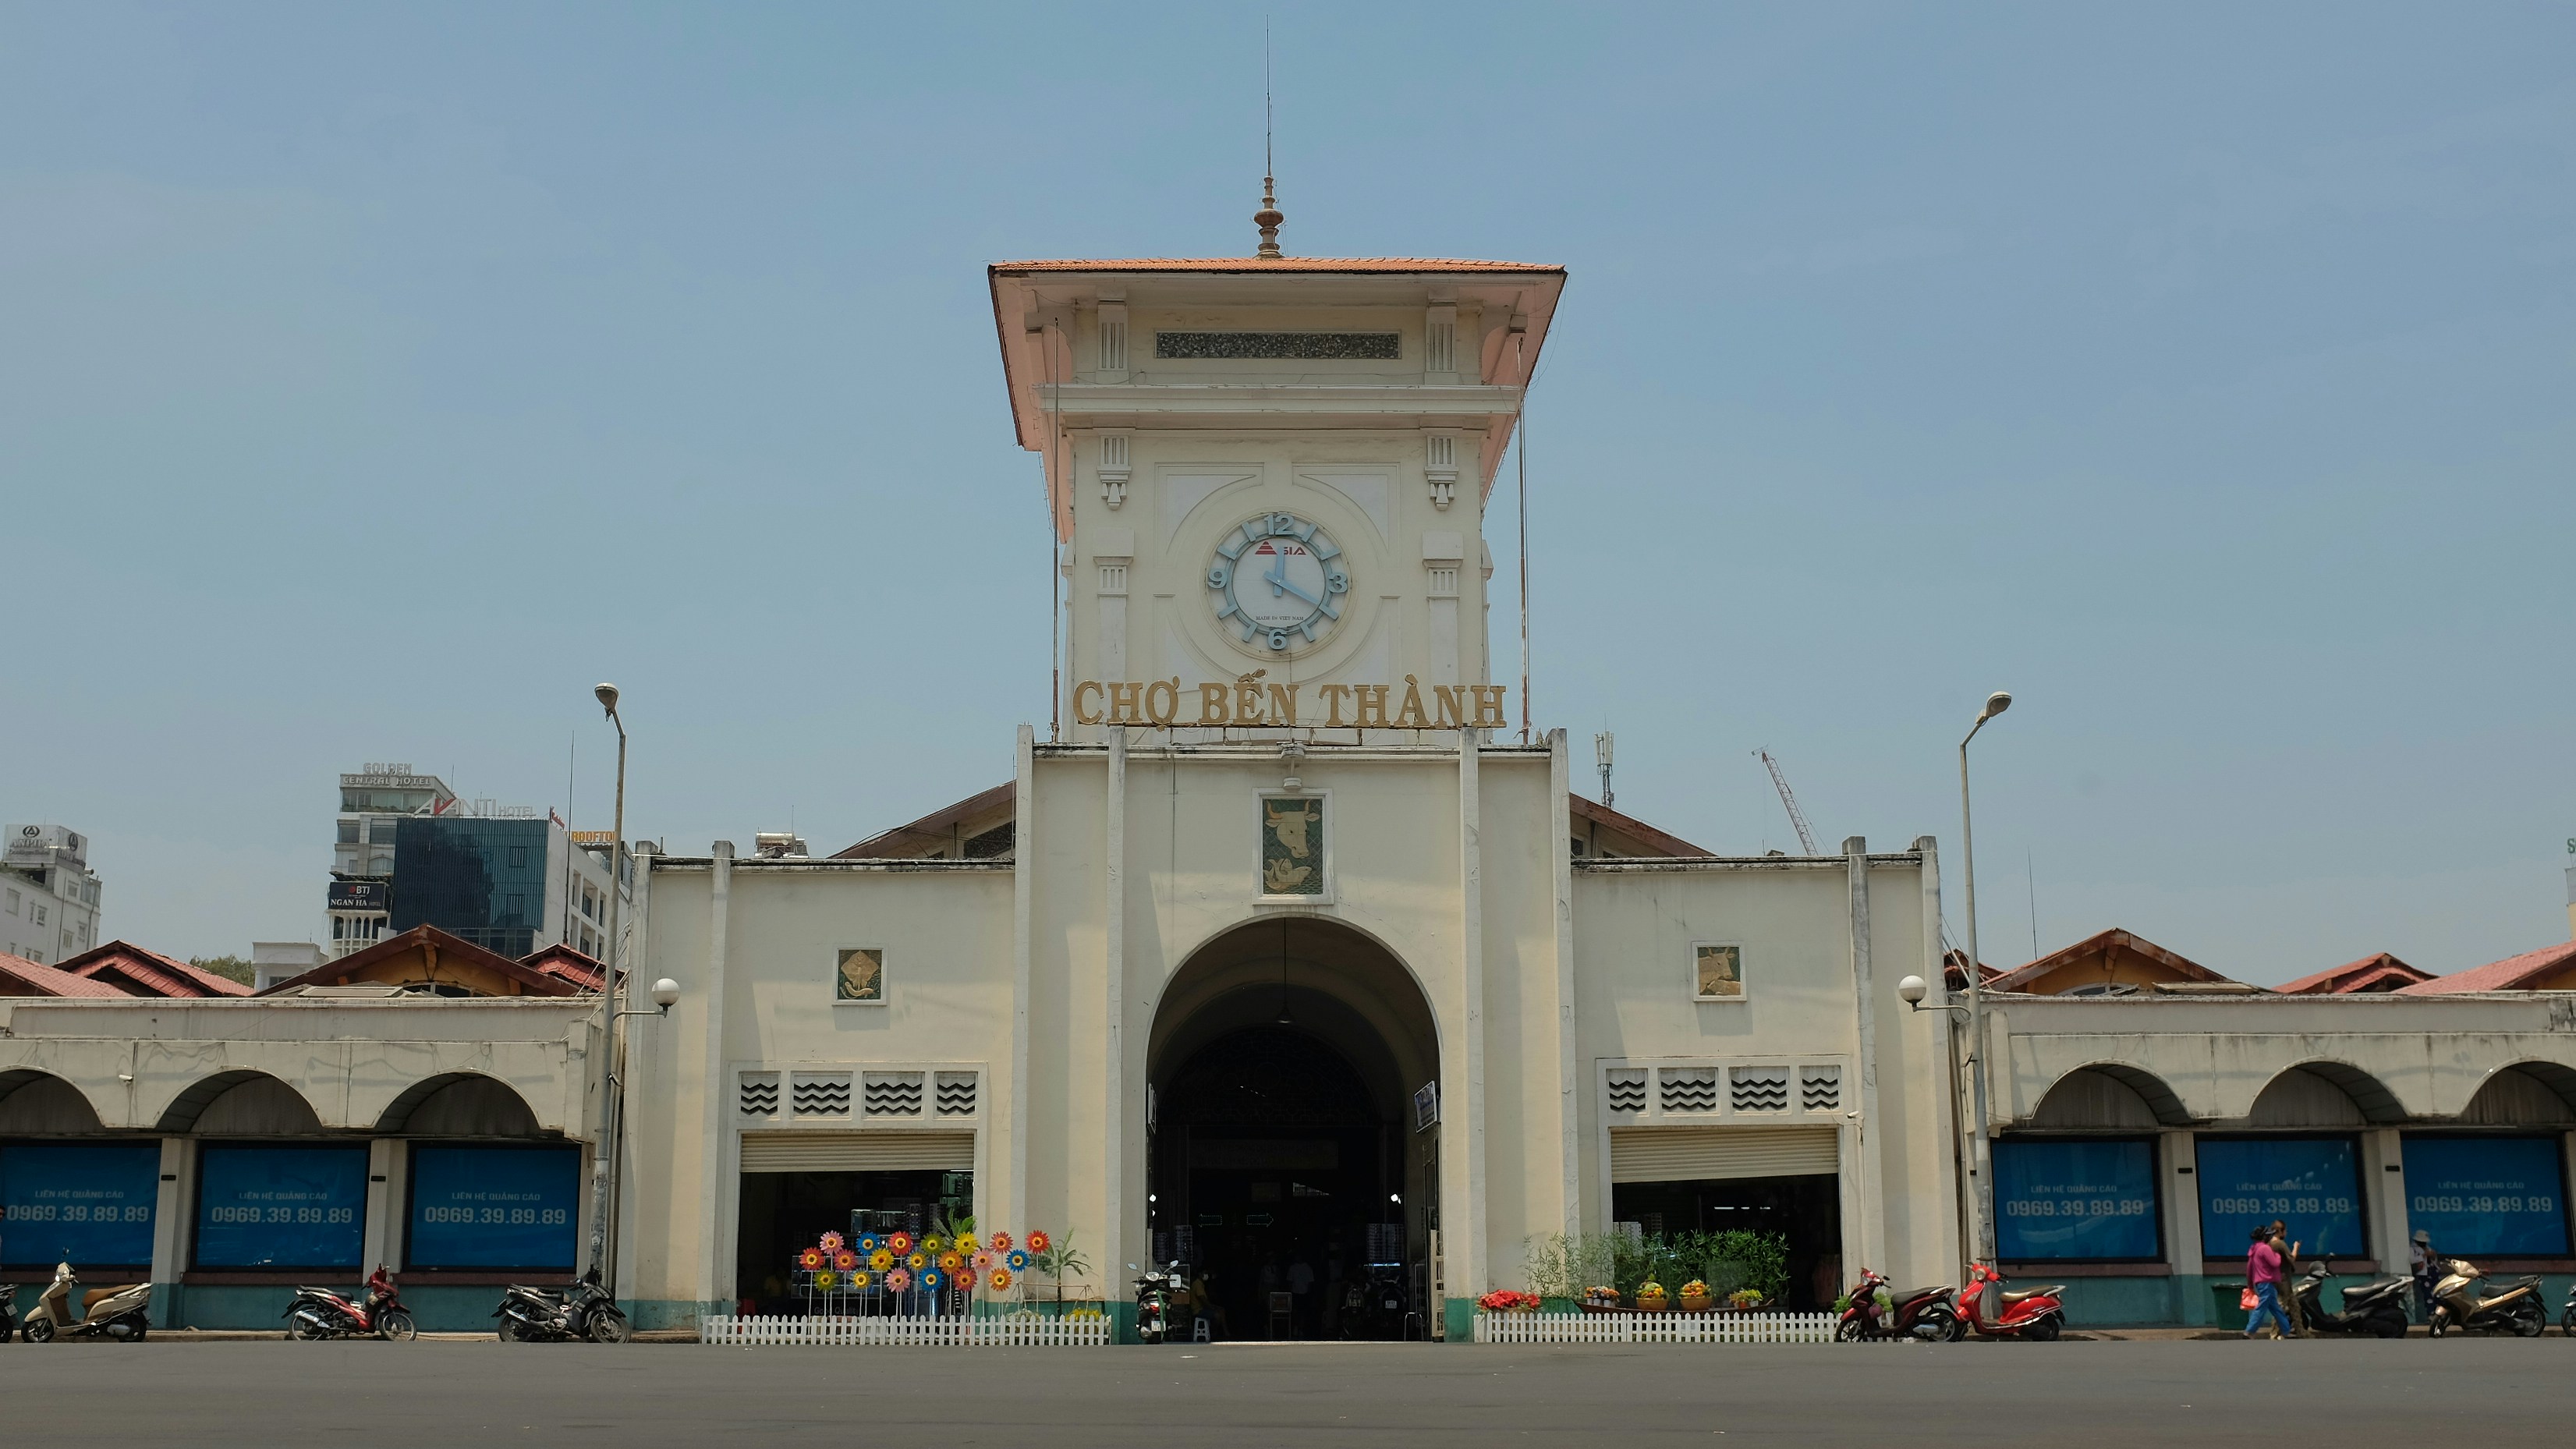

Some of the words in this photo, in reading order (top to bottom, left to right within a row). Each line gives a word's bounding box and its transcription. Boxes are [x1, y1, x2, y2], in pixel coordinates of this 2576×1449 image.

[1263, 514, 1295, 537] 12
[1207, 569, 1228, 589] 9
[1328, 572, 1348, 593] 3
[1268, 628, 1288, 650] 6
[1072, 675, 1180, 732] CHỢ
[1198, 668, 1299, 725] BẾN
[1319, 673, 1507, 728] THÀNH
[363, 762, 413, 775] GOLDEN
[396, 776, 431, 785] HOTEL
[413, 798, 497, 817] AVANTI
[498, 806, 537, 817] HOTEL
[572, 831, 616, 842] ROOFTO
[2567, 838, 2576, 854] S
[35, 1189, 55, 1199] LIÊN
[58, 1190, 70, 1199] HỆ
[105, 1190, 124, 1199] CÁO
[2031, 1184, 2050, 1193] LIÊN
[2053, 1185, 2065, 1194] HỆ
[2099, 1184, 2117, 1193] CÁO
[2438, 1181, 2458, 1189] LIÊN
[2460, 1182, 2472, 1191] HỆ
[2507, 1181, 2525, 1189] CÁO
[239, 1191, 259, 1200] LIÊN
[261, 1191, 274, 1201] HỆ
[308, 1191, 328, 1200] CÁO
[452, 1191, 472, 1200] LIÊN
[474, 1191, 487, 1202] HỆ
[522, 1192, 540, 1201] CÁO
[2414, 1196, 2553, 1213] 0969.39.89.89
[6, 1204, 150, 1223] 0969.39.89.89
[2006, 1199, 2145, 1217] 0969.39.89.89
[2212, 1197, 2350, 1214] 0969.39.89.89
[211, 1206, 353, 1224] 0969.39.89.89
[424, 1206, 566, 1225] 0969.39.89.89
